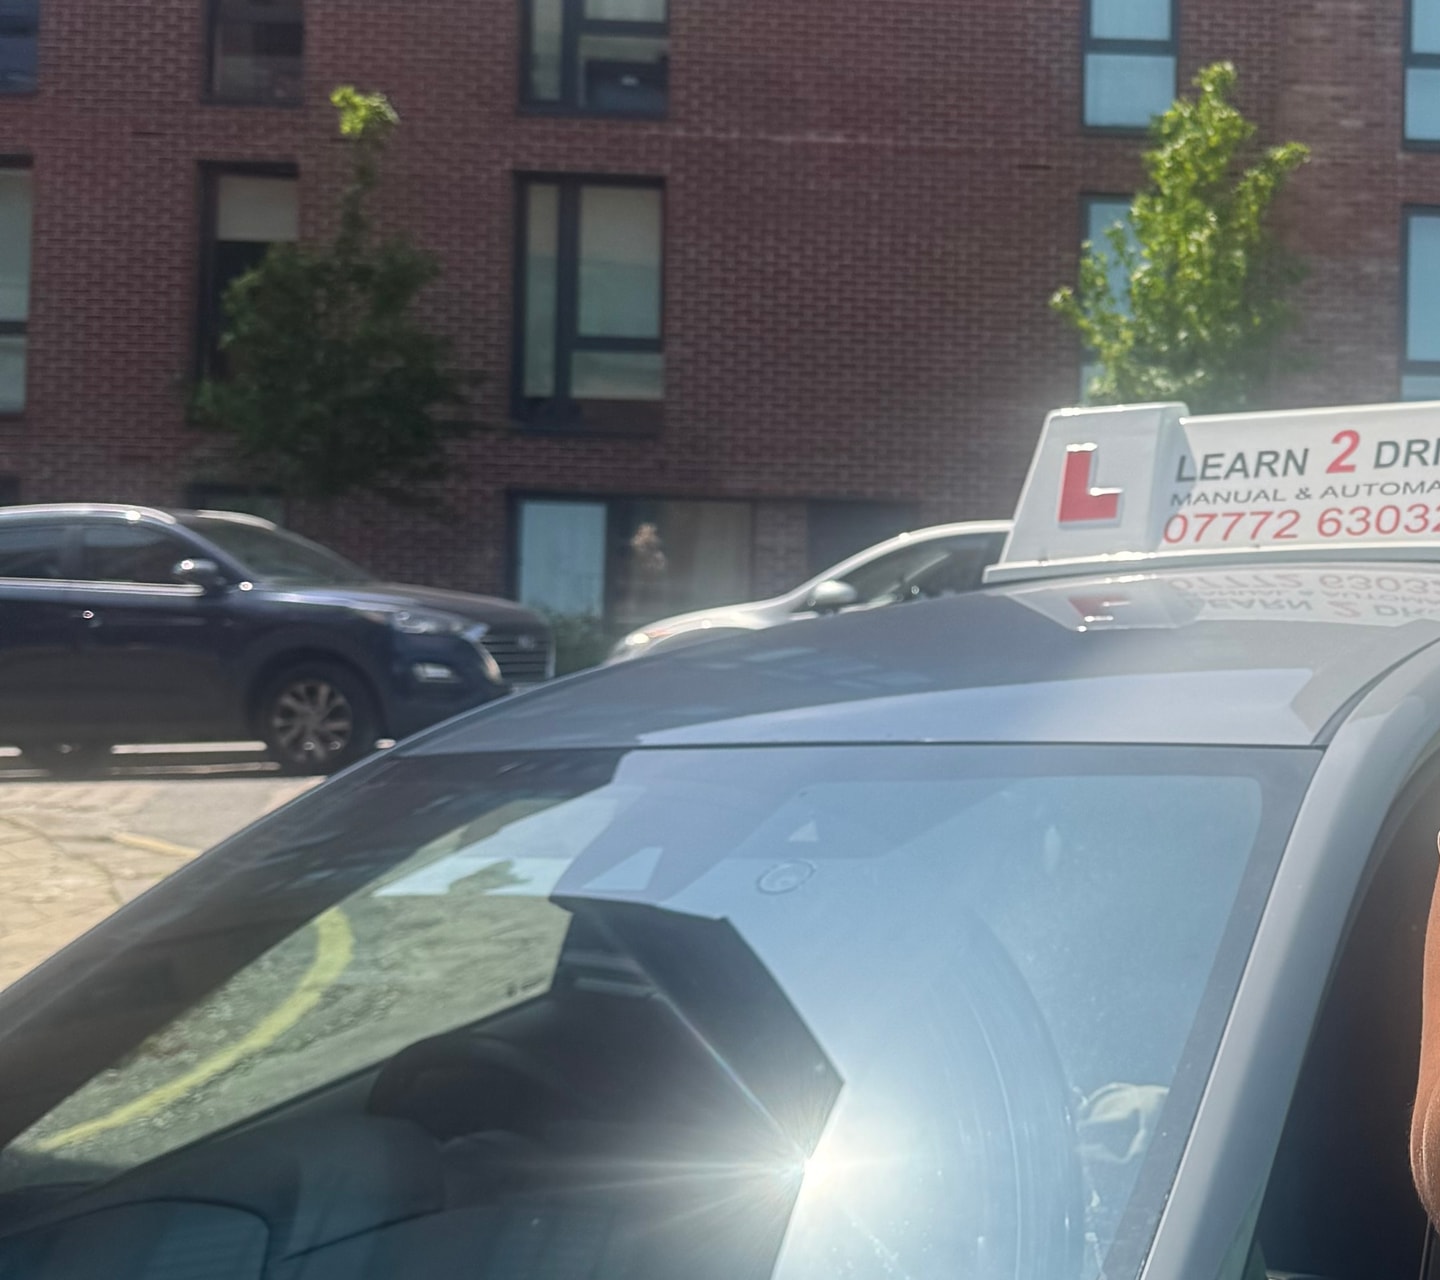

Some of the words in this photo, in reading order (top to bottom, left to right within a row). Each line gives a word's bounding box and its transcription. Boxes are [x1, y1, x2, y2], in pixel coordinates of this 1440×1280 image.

[1175, 447, 1310, 483] LEARN
[1325, 429, 1361, 474] 2
[1056, 441, 1123, 523] L
[1170, 487, 1288, 507] MANUAL
[1294, 486, 1313, 501] &
[1162, 508, 1302, 544] 07772
